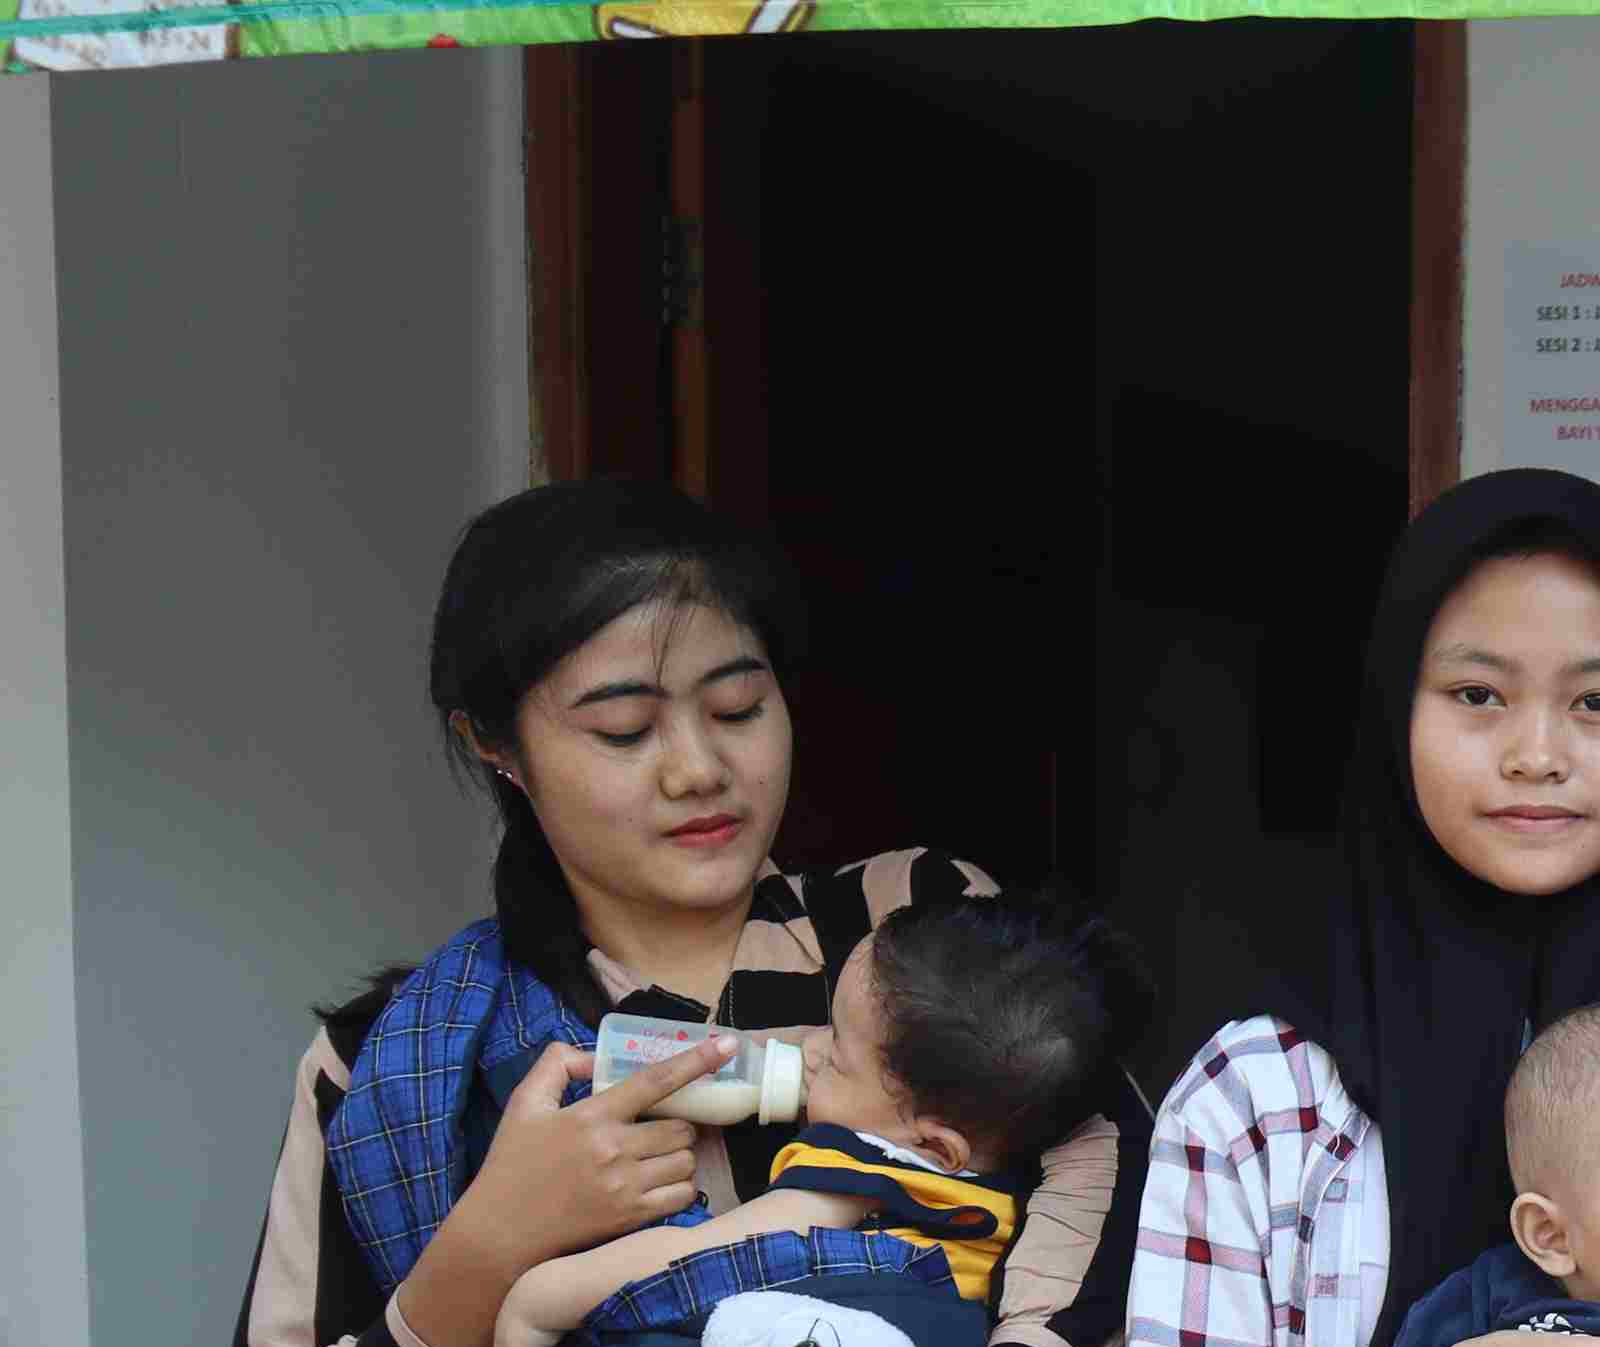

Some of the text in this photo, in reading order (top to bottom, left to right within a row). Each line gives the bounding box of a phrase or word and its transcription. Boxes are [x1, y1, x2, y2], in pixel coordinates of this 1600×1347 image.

[1536, 306, 1568, 321] SESI
[1536, 338, 1568, 352] SESI
[1557, 425, 1592, 440] BAYI
